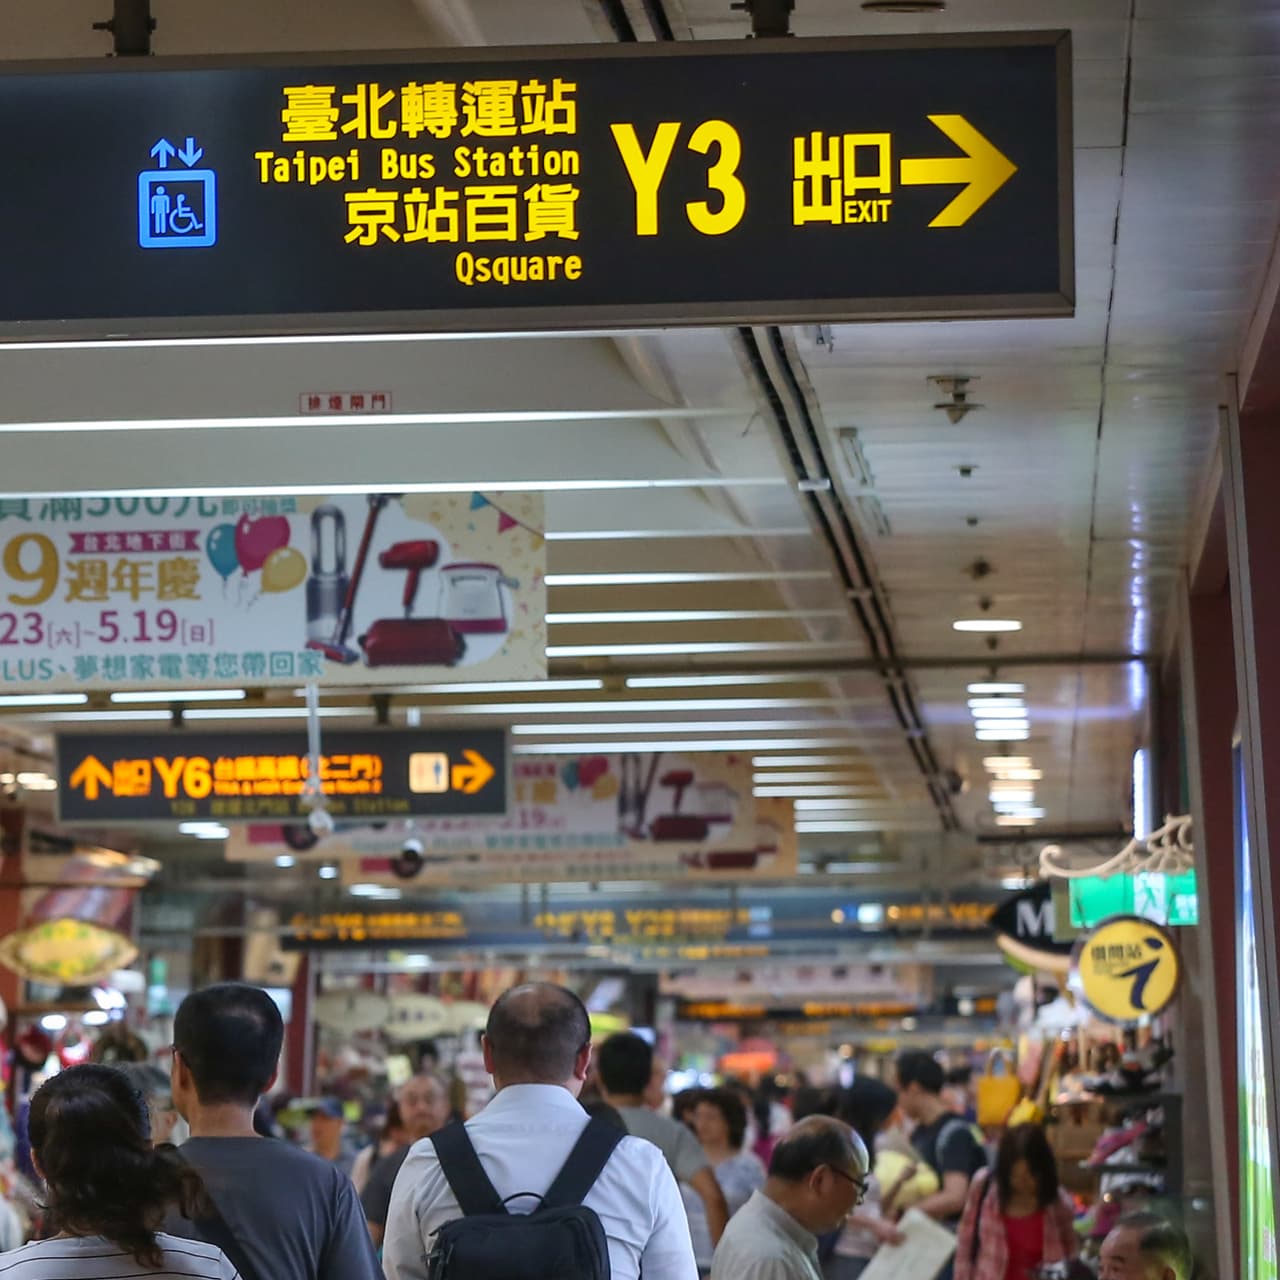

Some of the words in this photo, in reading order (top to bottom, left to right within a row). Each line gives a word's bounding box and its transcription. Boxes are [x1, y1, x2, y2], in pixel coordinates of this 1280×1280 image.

[282, 79, 577, 141] 臺北轉運站
[255, 149, 359, 185] Taipei
[382, 149, 435, 179] Bus
[454, 145, 580, 177] Station
[611, 119, 746, 236] Y3
[793, 131, 893, 225] 出口
[344, 183, 579, 245] 京站百貨
[844, 199, 893, 224] EXIT
[455, 251, 582, 286] Qsquare
[64, 556, 202, 602] 週年慶
[152, 755, 213, 799] Y6
